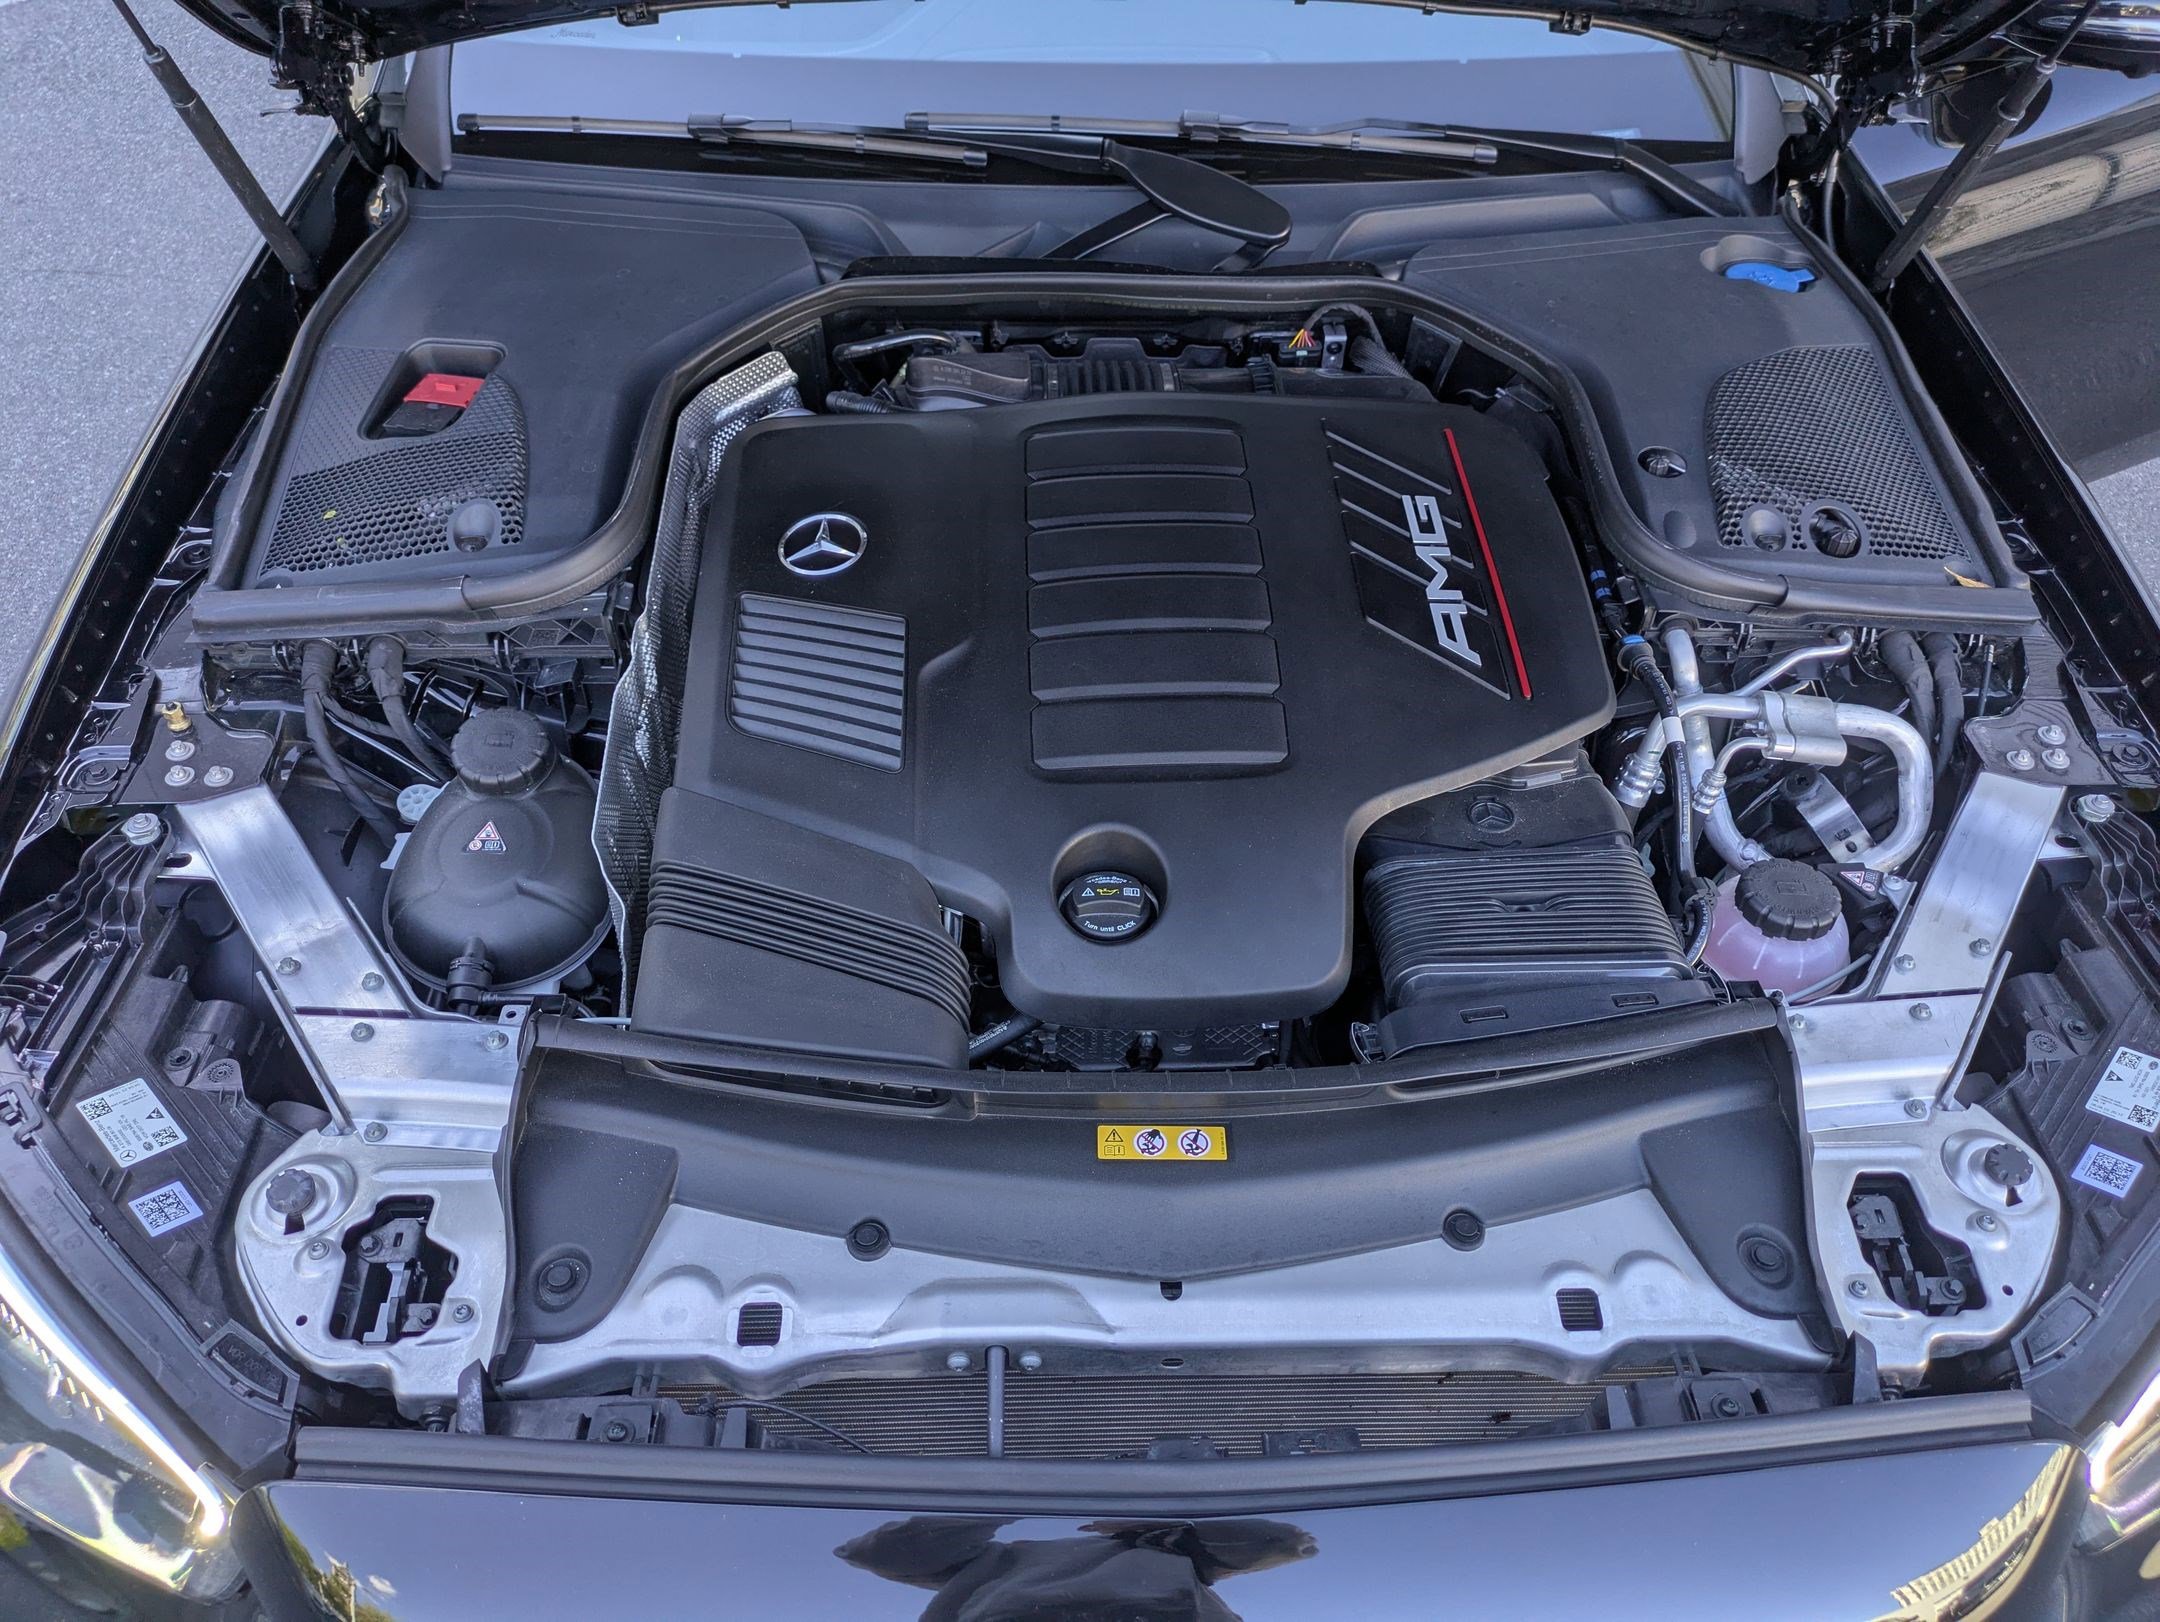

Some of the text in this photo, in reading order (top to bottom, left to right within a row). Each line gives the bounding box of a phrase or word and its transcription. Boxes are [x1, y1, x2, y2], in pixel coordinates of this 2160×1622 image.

[1401, 494, 1482, 666] AMG
[1084, 920, 1098, 931] Turn
[1116, 920, 1137, 931] CLICK
